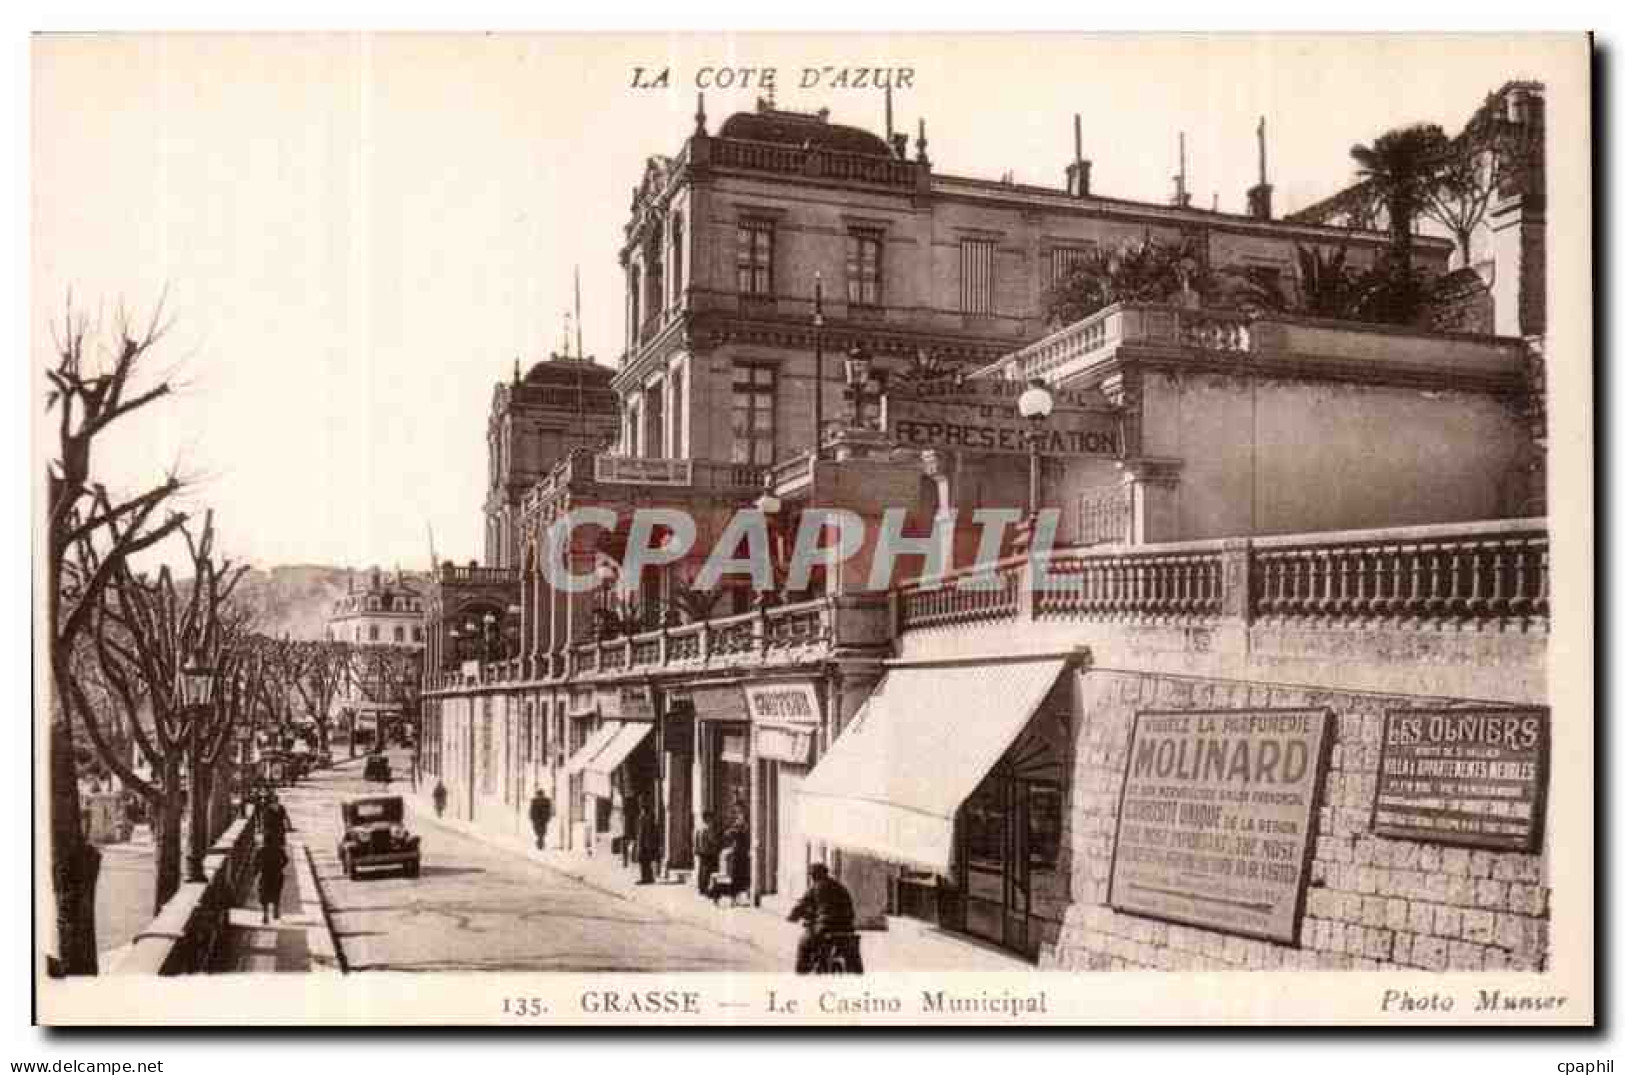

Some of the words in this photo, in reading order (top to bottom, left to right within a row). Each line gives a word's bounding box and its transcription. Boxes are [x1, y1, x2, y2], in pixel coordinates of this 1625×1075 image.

[1197, 717, 1216, 732] LA
[1388, 714, 1422, 746] LES
[1428, 714, 1538, 750] OLIVIERS
[1134, 738, 1309, 783] MOLINARD
